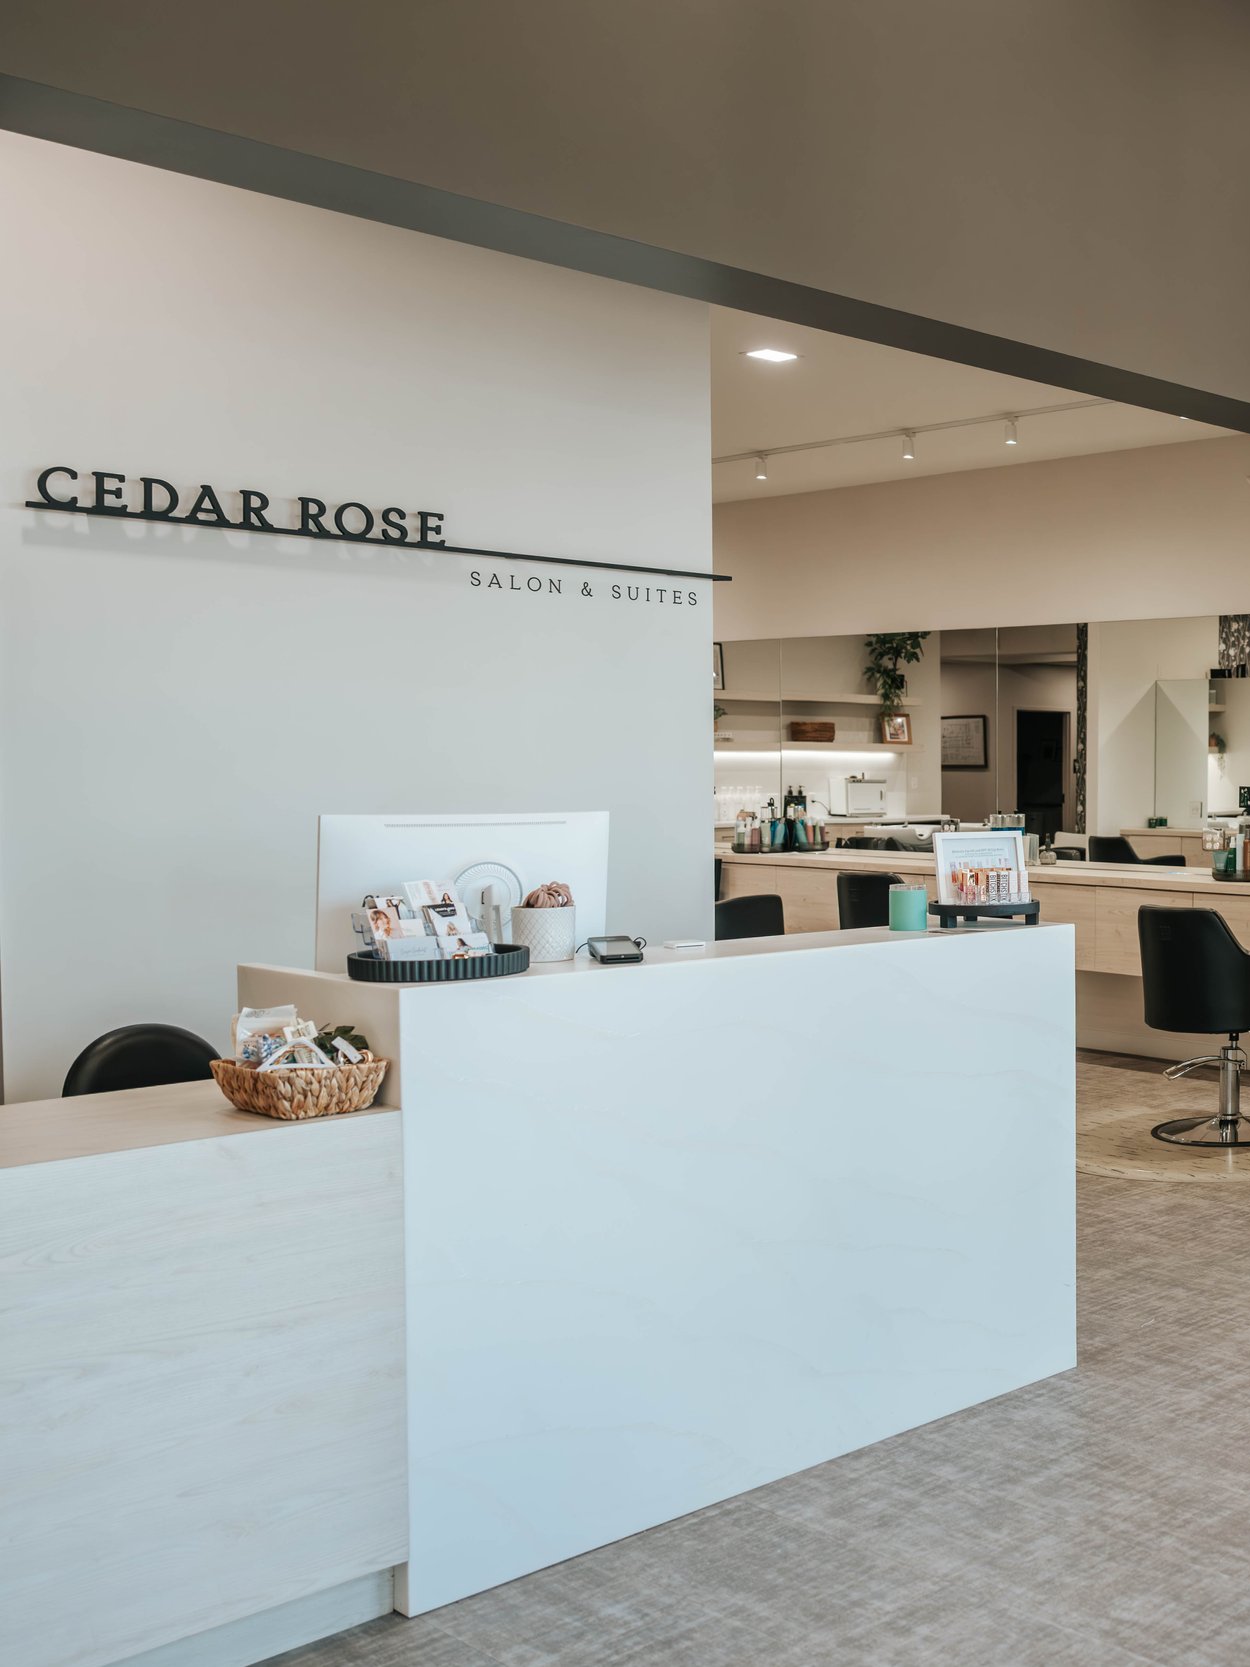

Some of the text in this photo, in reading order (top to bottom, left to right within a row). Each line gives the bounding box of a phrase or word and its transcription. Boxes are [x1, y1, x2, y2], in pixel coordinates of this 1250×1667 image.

[37, 466, 446, 547] CEDAR ROSE
[470, 571, 698, 606] SALON & SUITES
